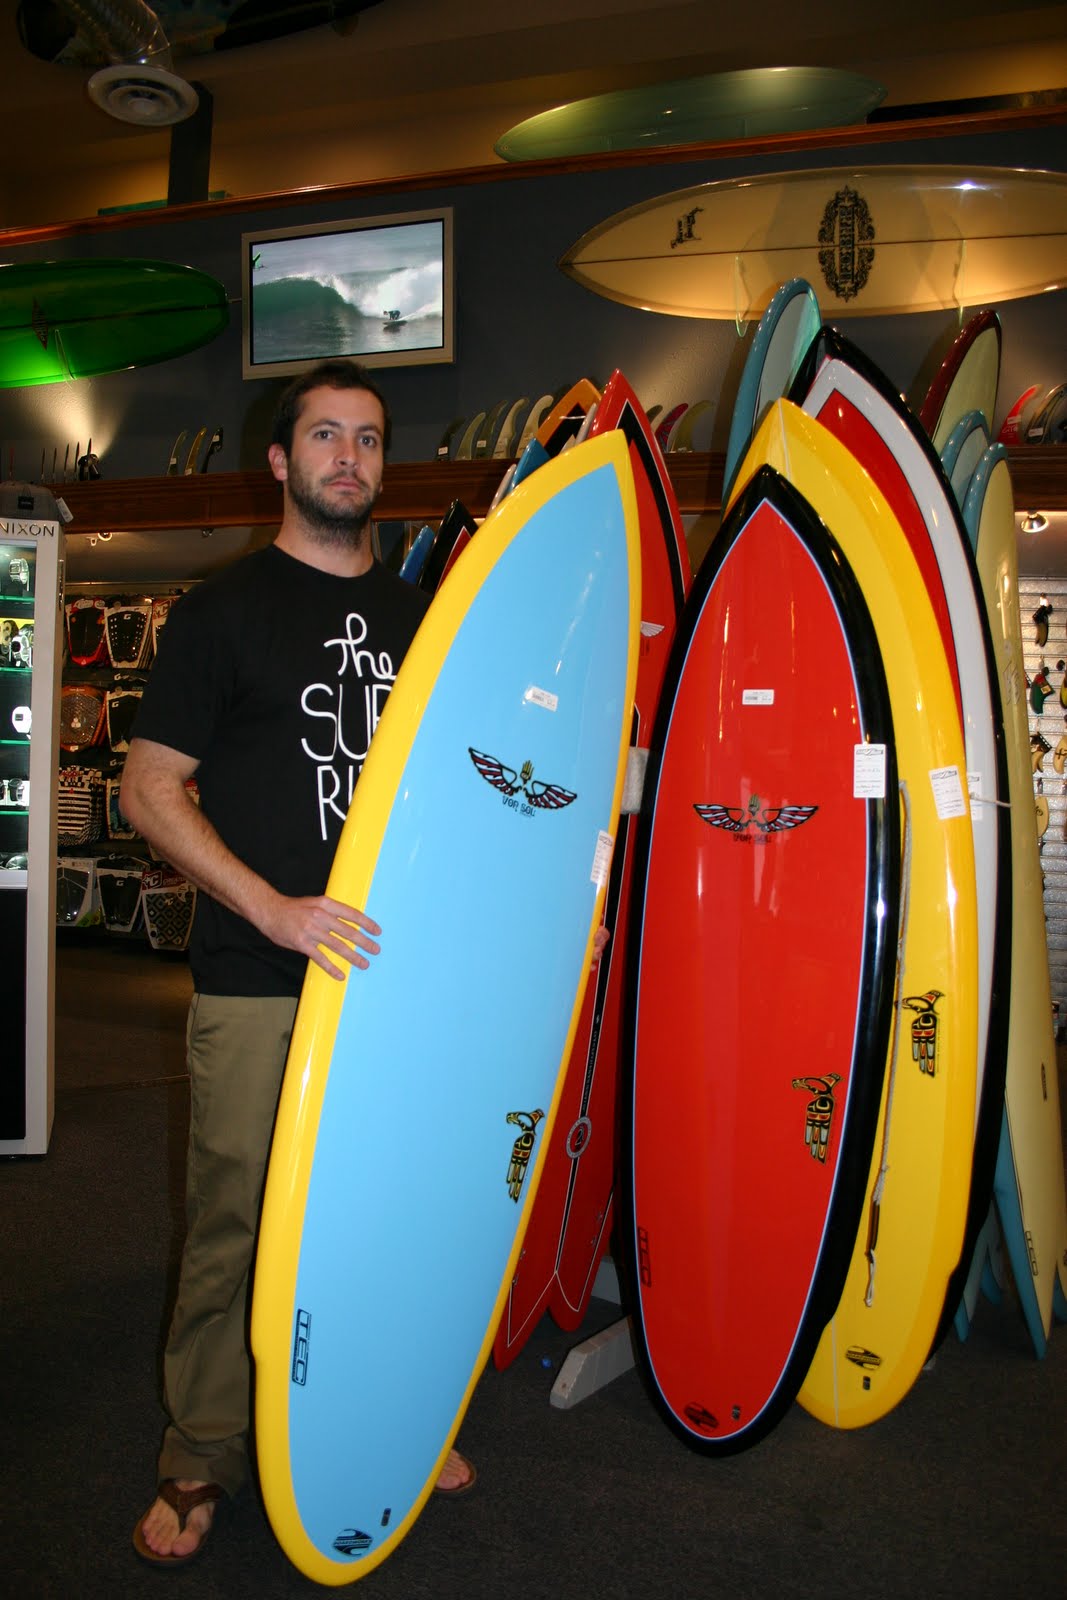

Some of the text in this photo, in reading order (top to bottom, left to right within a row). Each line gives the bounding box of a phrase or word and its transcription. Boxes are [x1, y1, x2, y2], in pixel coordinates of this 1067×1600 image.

[0, 522, 55, 537] NIXON
[317, 765, 363, 841] RI
[293, 1310, 311, 1385] TEC
